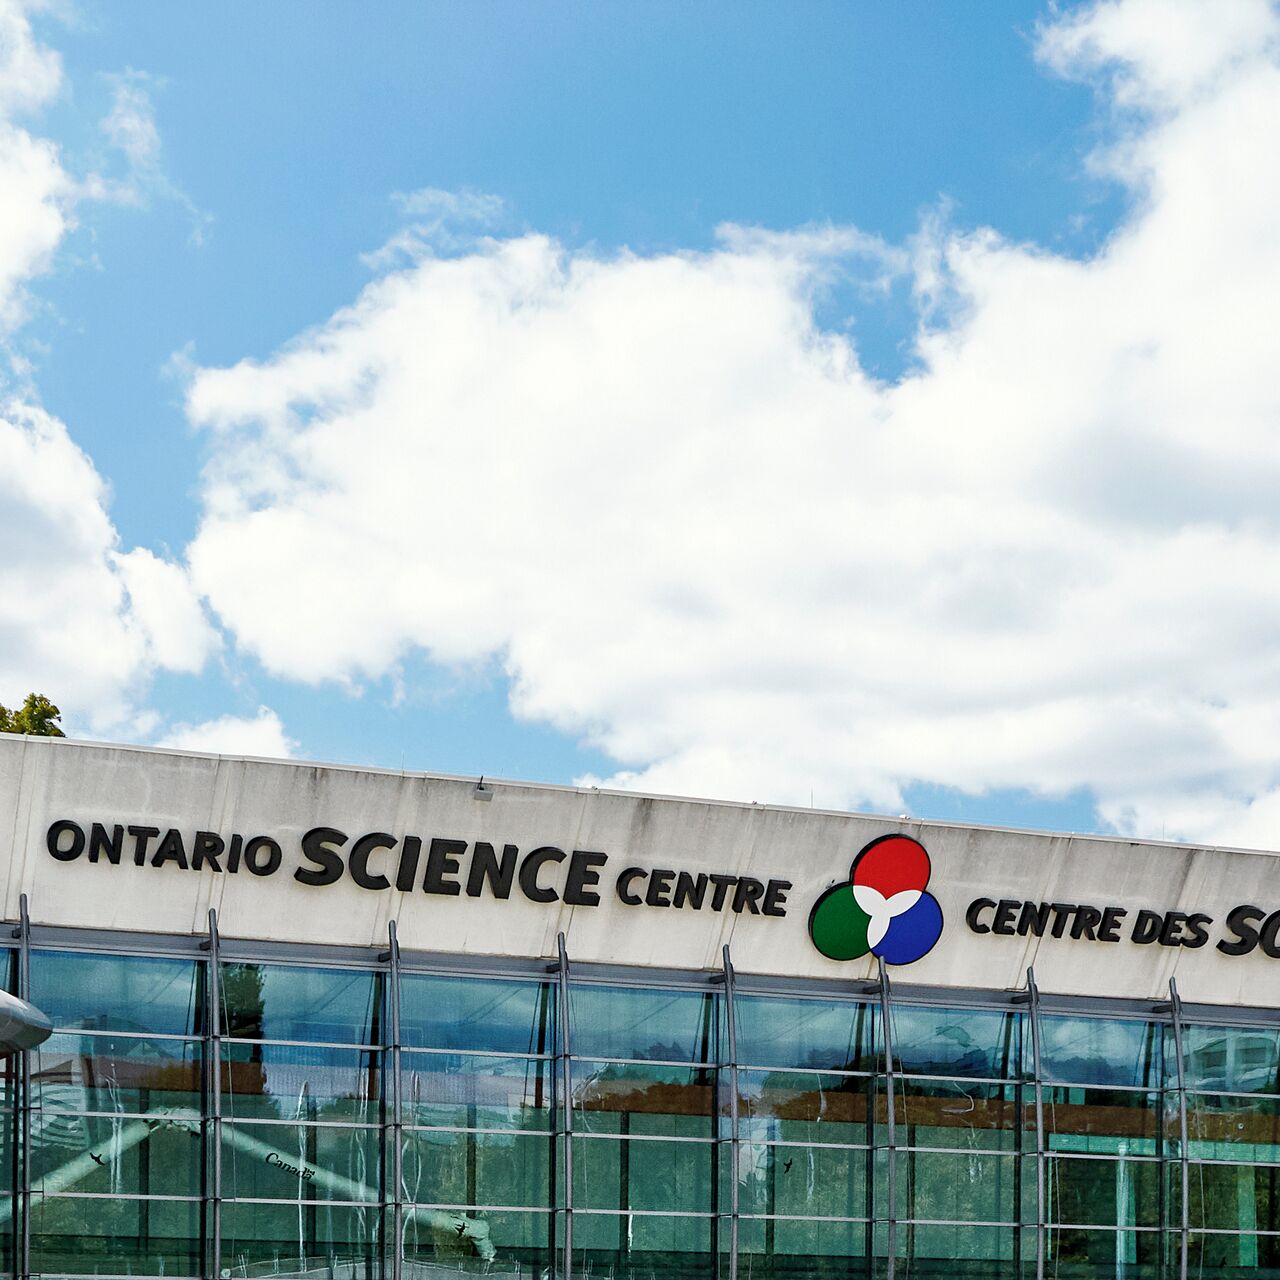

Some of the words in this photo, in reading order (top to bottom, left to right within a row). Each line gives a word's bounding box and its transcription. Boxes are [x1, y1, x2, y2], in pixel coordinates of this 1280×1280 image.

[46, 819, 283, 877] ONTARIO
[293, 826, 609, 907] SCIENCE
[615, 866, 793, 918] CENTRE
[965, 897, 1128, 943] CENTRE
[1130, 909, 1214, 949] DES
